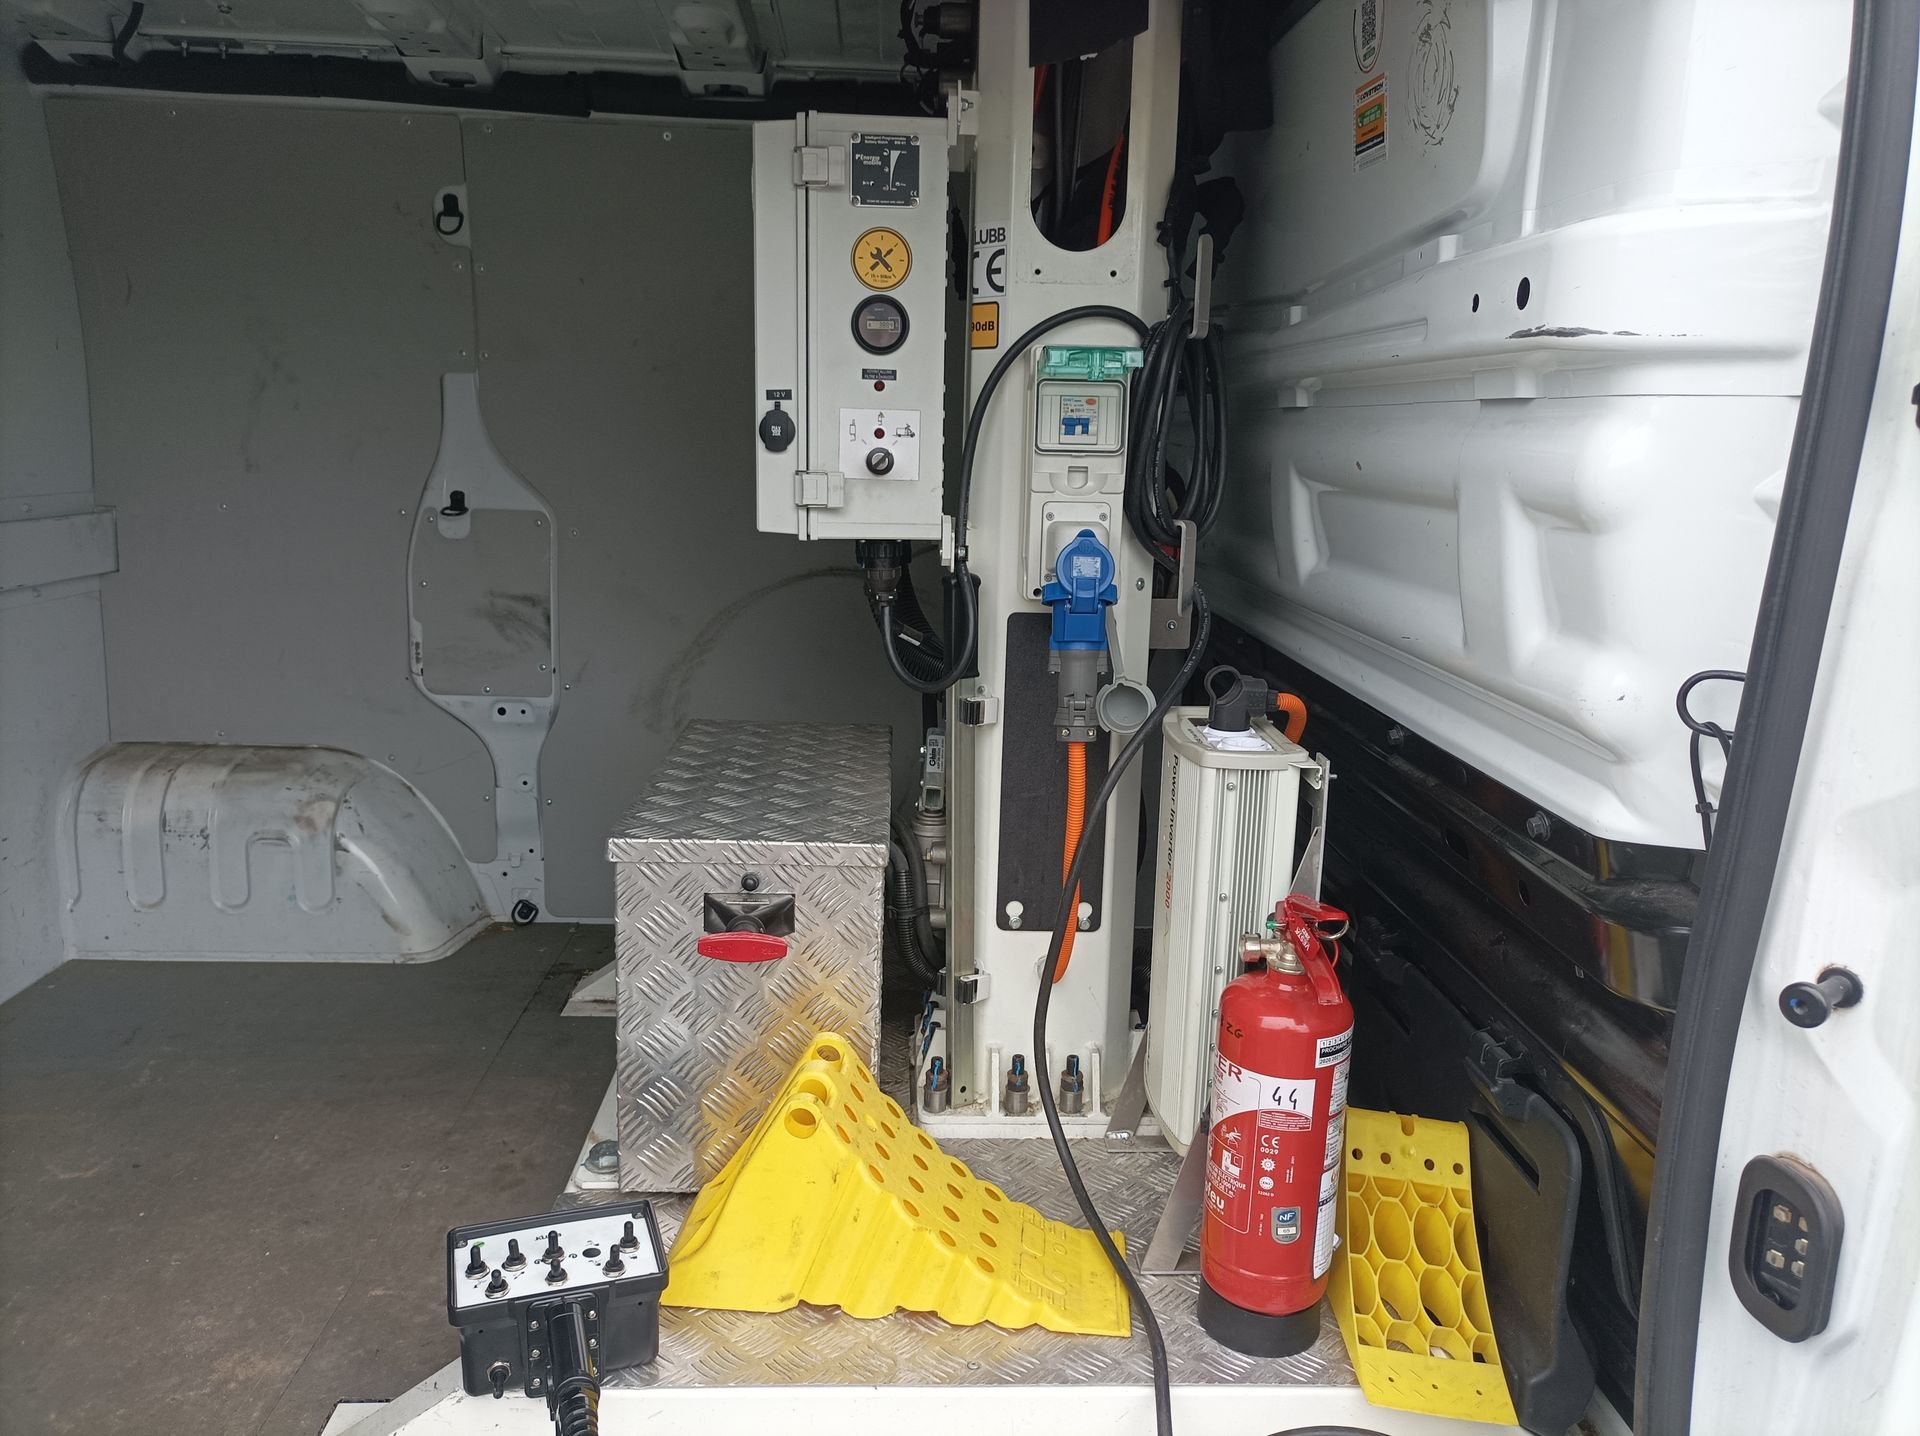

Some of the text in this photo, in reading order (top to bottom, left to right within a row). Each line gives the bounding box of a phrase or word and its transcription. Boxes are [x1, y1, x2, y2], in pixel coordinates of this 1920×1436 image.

[974, 227, 1006, 245] LUBB
[1170, 754, 1179, 809] Power
[1167, 808, 1176, 872] Inverter
[1279, 1212, 1295, 1221] NF
